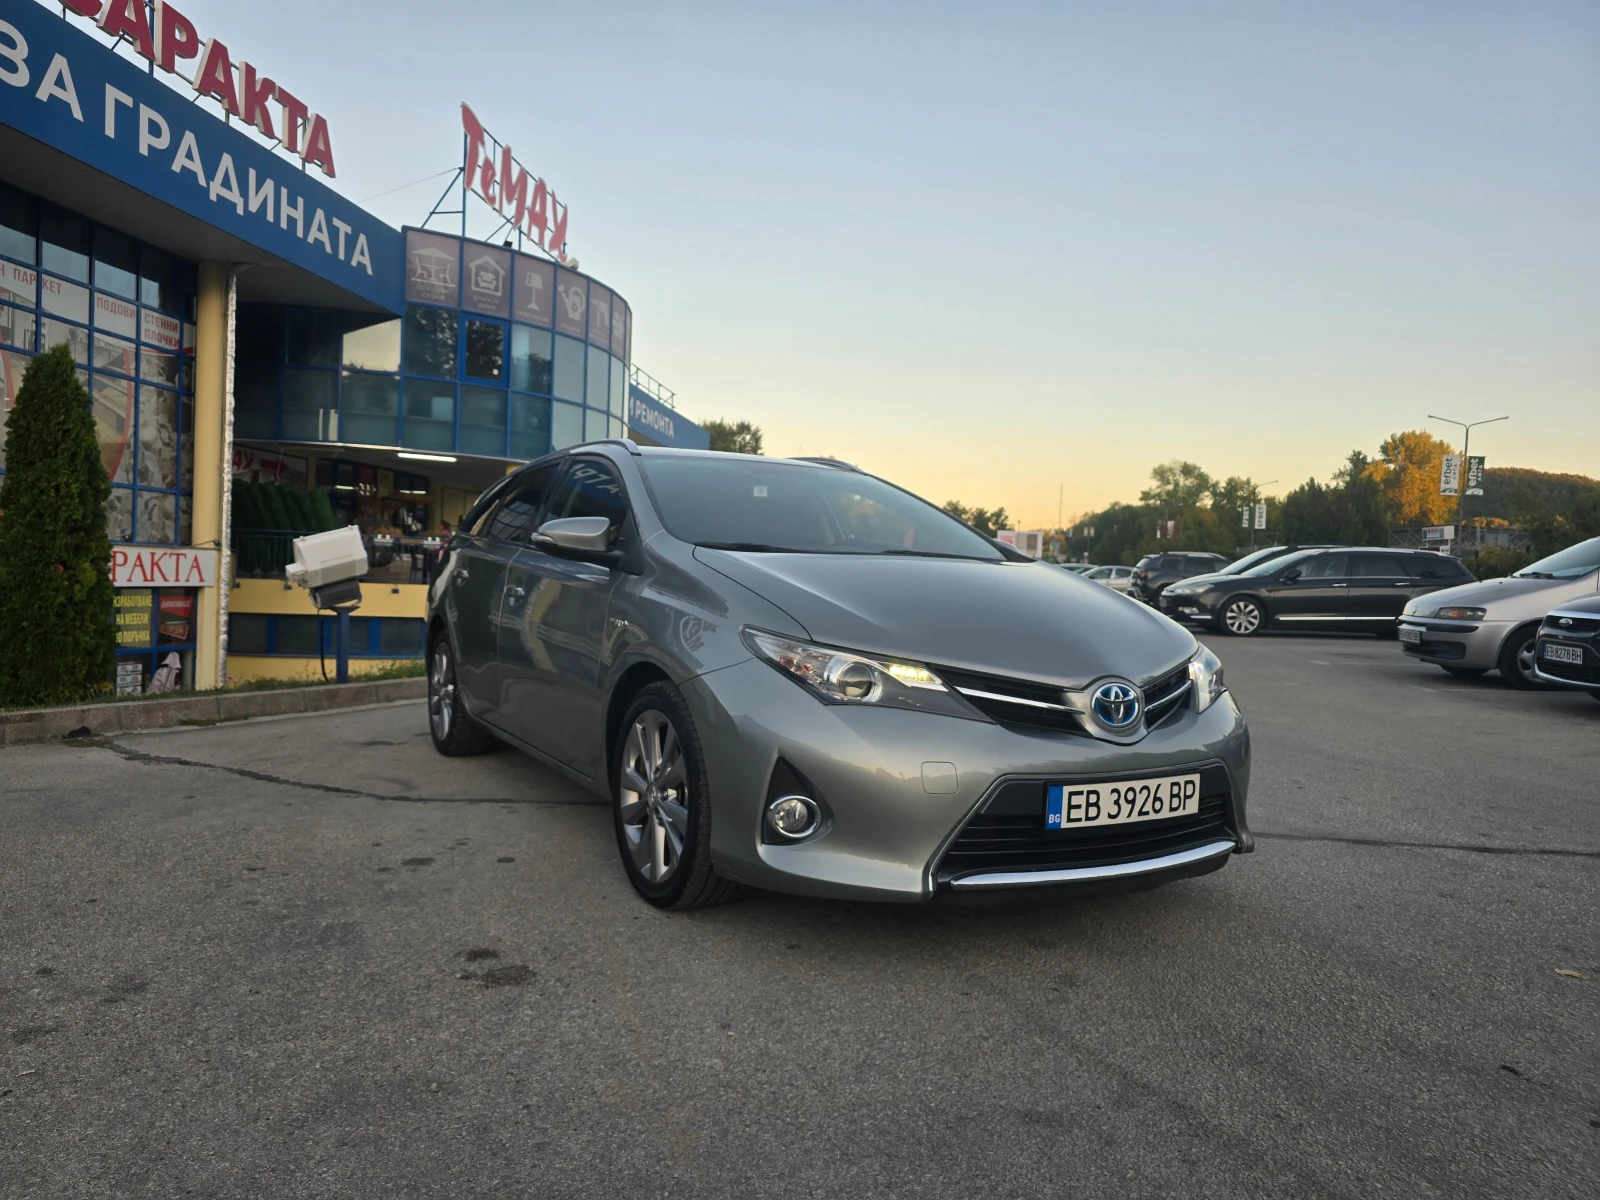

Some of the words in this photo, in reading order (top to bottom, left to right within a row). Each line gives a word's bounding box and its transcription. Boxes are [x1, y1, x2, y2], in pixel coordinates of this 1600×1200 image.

[58, 0, 336, 178] АРАКТА
[0, 19, 84, 122] ЗА
[104, 82, 374, 276] ГРАДИНАТА
[96, 297, 136, 319] ПОДОВИ
[144, 312, 178, 333] СТЕННИ
[144, 328, 180, 347] ПЛОЧКИ
[635, 400, 675, 439] РЕМОНТА
[1443, 457, 1453, 485] efbet
[1468, 458, 1479, 487] efbet
[1066, 789, 1101, 823] EB
[1107, 783, 1164, 820] 3926
[1168, 779, 1196, 813] BP
[1048, 813, 1061, 824] BG
